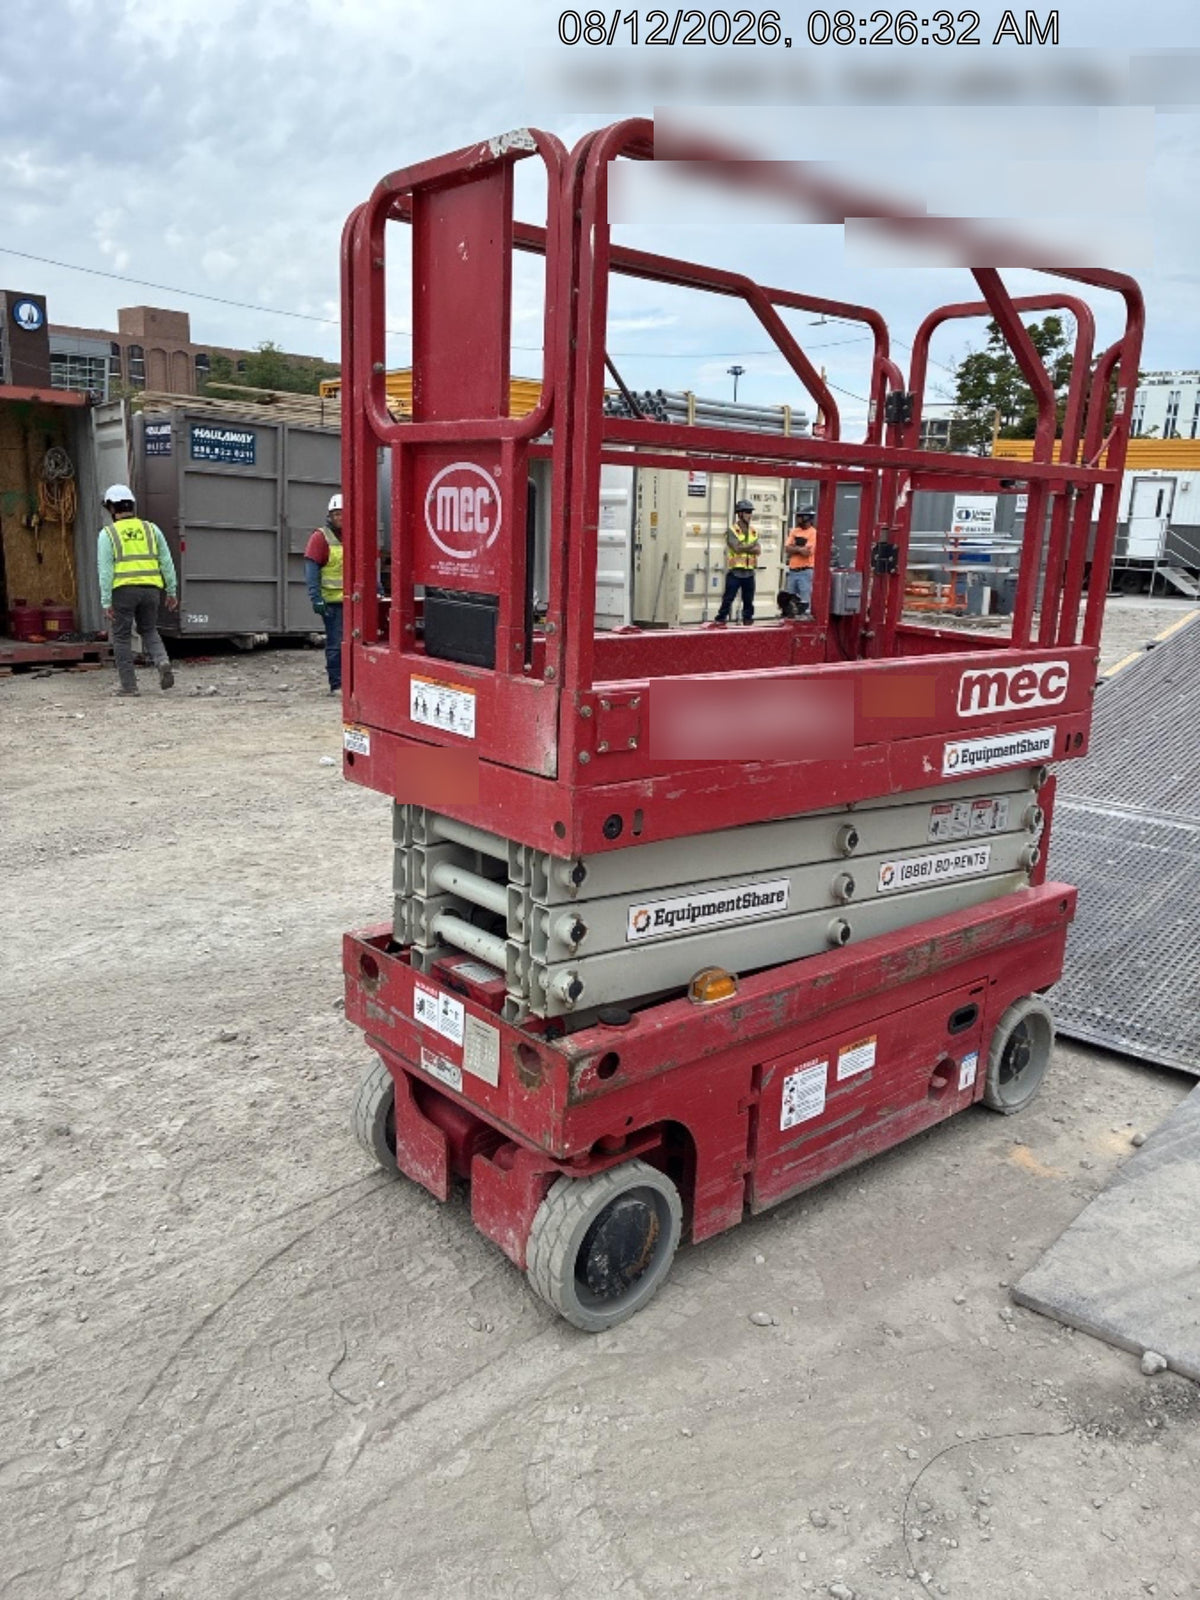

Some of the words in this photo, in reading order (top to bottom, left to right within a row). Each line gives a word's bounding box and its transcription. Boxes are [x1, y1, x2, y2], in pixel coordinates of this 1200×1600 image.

[193, 428, 253, 443] HAULAWAY
[961, 738, 1051, 766] EquipmentShare
[654, 889, 785, 927] EquipmentShare
